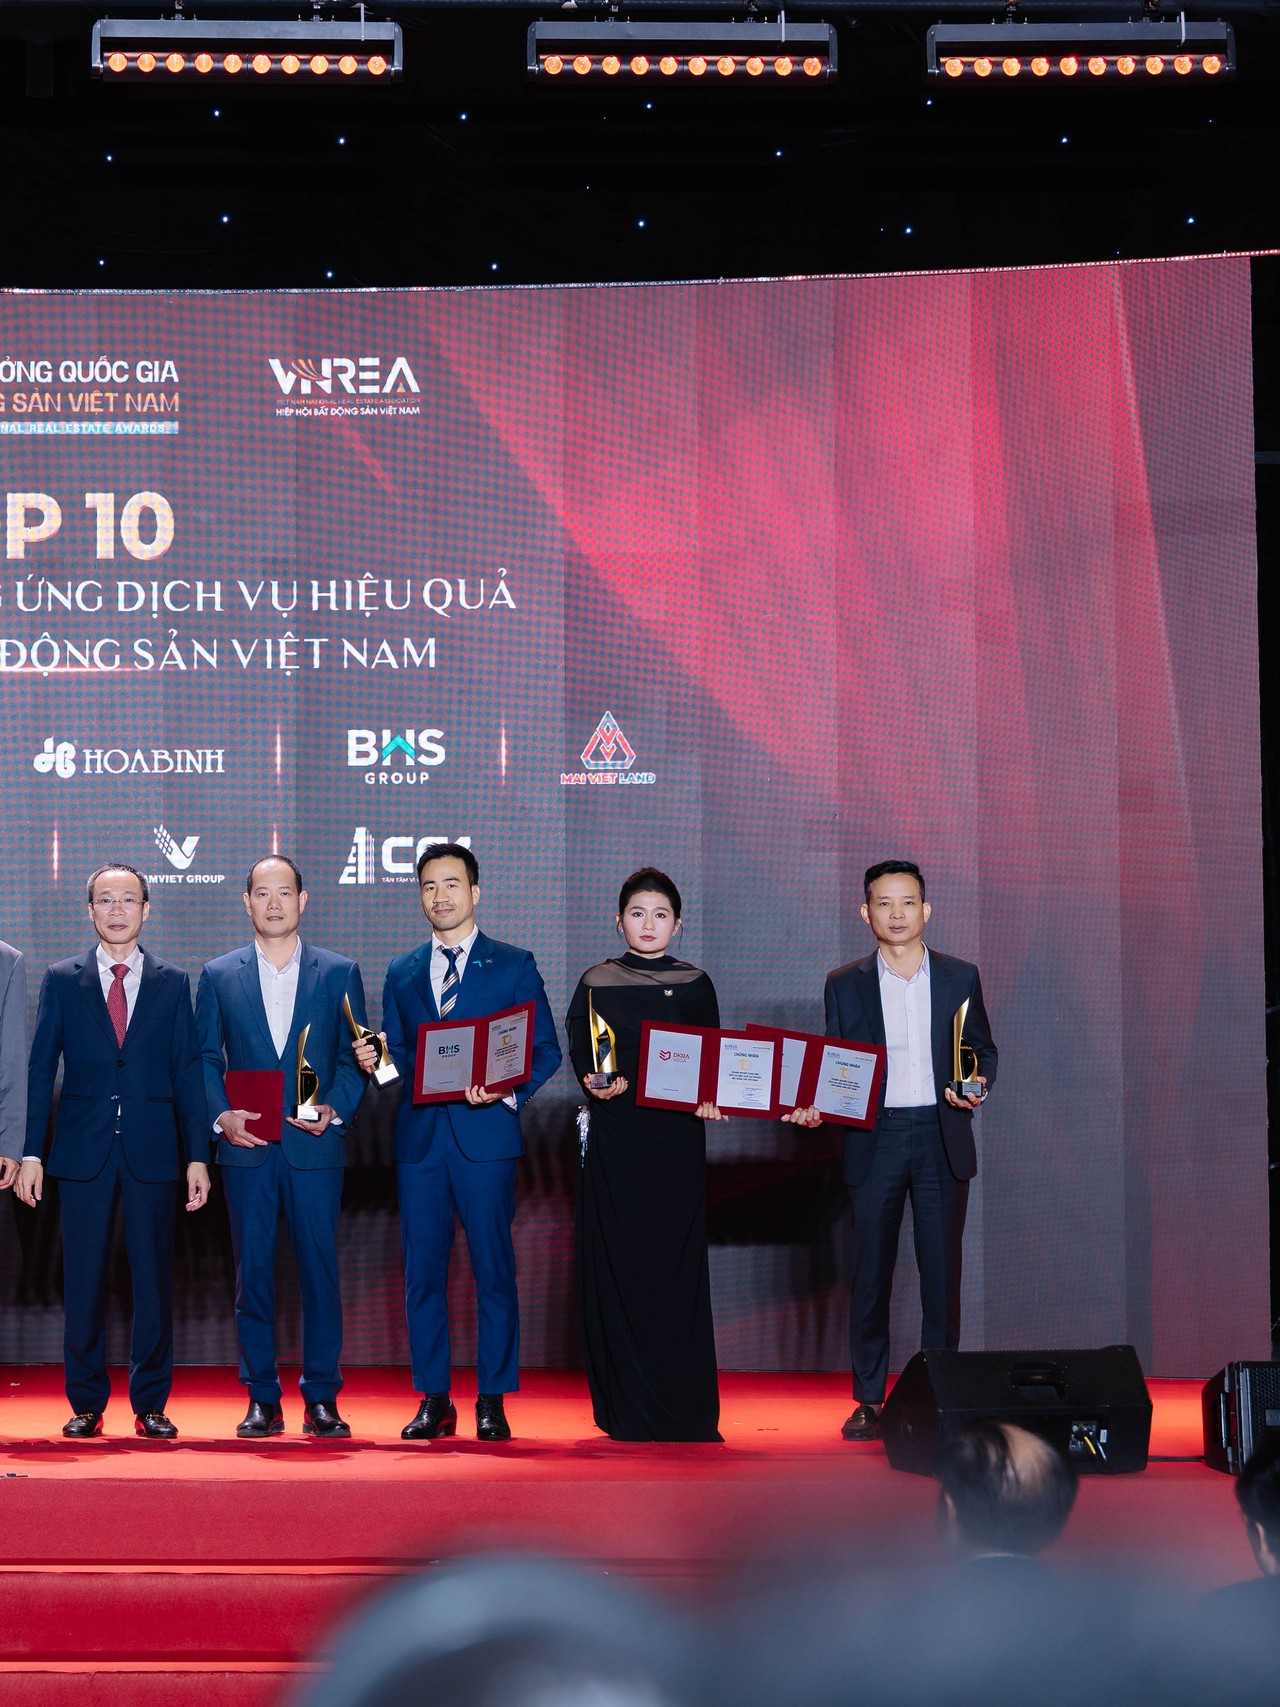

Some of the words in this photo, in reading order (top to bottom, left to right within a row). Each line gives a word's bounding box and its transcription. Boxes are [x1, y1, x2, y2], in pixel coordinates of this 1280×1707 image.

[59, 355, 129, 383] QUỐC
[136, 360, 179, 382] GIA
[268, 357, 420, 394] VNREA
[12, 387, 61, 412] SẢN
[68, 389, 118, 415] VIỆT
[125, 392, 179, 412] NAM
[30, 423, 59, 433] REAL
[66, 423, 109, 433] ESTATE
[85, 491, 175, 560] 10
[16, 574, 103, 611] ỨNG
[117, 580, 223, 618] DỊCH
[237, 580, 298, 618] VỤ
[311, 572, 411, 617] HIỆU
[422, 568, 516, 617] QUẢ
[133, 629, 218, 669] SẢN
[231, 631, 329, 676] VIỆT
[341, 637, 436, 668] NAM
[83, 749, 225, 773] HOABINH
[348, 729, 445, 766] BHS
[365, 772, 429, 784] GROUP
[560, 773, 586, 784] MAI
[587, 772, 618, 784] VIET
[619, 772, 656, 784] LAND
[186, 875, 225, 883] GROUP
